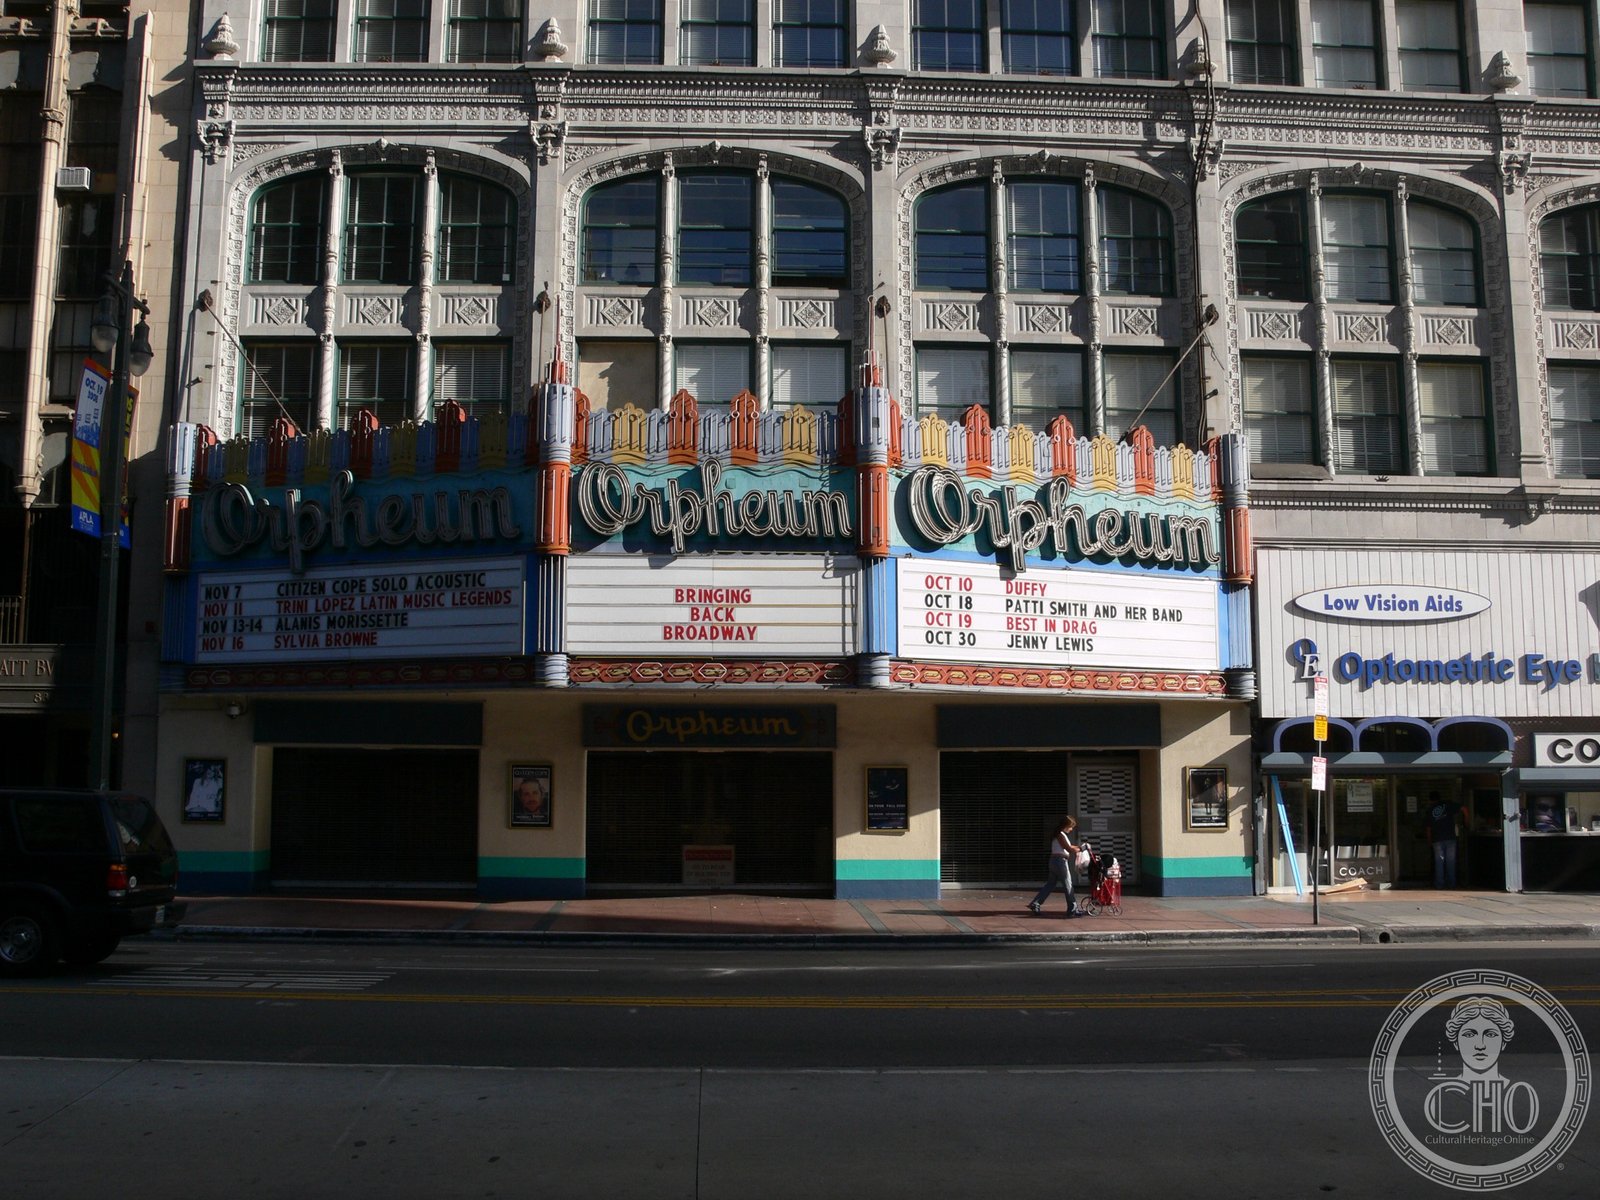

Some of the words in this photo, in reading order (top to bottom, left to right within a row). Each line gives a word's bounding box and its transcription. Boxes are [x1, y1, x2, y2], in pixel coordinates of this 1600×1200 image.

[577, 457, 854, 553] Orpheum
[201, 469, 521, 574] Orpheum
[908, 464, 1221, 573] Orpheum
[205, 586, 228, 600] NOV
[233, 585, 241, 599] 7
[276, 581, 326, 597] CITIZEN
[332, 579, 367, 595] COPE
[371, 576, 408, 592] SOLO
[415, 572, 487, 590] ACOUSTIC
[674, 588, 752, 604] BRINGING
[924, 575, 952, 591] OCT
[958, 576, 973, 592] 10
[1005, 579, 1047, 597] DUFFY
[204, 603, 227, 617] NOV
[234, 602, 243, 616] 11
[275, 599, 309, 615] TRINI
[314, 597, 356, 613] LOPEZ
[360, 594, 398, 611] LATIN
[403, 592, 446, 609] MUSIC
[451, 589, 512, 607] LEGENDS
[690, 606, 736, 622] BACK
[924, 593, 952, 609] OCT
[958, 595, 973, 610] 18
[1005, 598, 1044, 614] PATTI
[1049, 601, 1087, 617] SMITH
[1094, 604, 1117, 619] AND
[1125, 606, 1147, 621] HER
[1152, 607, 1183, 623] BAND
[1323, 593, 1360, 611] Low
[1364, 593, 1419, 612] Vision
[1424, 595, 1463, 613] Aids
[202, 620, 227, 634] NOV
[233, 618, 263, 633] 13-14
[275, 615, 321, 631] ALANIS
[327, 612, 409, 629] MORISSETTE
[662, 625, 758, 641] BROADWAY
[925, 611, 952, 627] OCT
[958, 613, 972, 628] 19
[1006, 616, 1039, 632] BEST
[1045, 618, 1057, 633] IN
[1063, 619, 1098, 635] DRAG
[202, 637, 225, 651] NOV
[232, 636, 244, 650] 16
[274, 633, 319, 649] SYLVIA
[325, 631, 378, 648] BROWNE
[925, 630, 952, 645] OCT
[957, 632, 977, 647] 30
[1006, 634, 1047, 650] JENNY
[1056, 636, 1094, 652] LEWIS
[1339, 651, 1515, 689] Optometric
[1525, 653, 1582, 689] Eye
[626, 709, 799, 743] Orpheum
[1339, 866, 1383, 876] COACH
